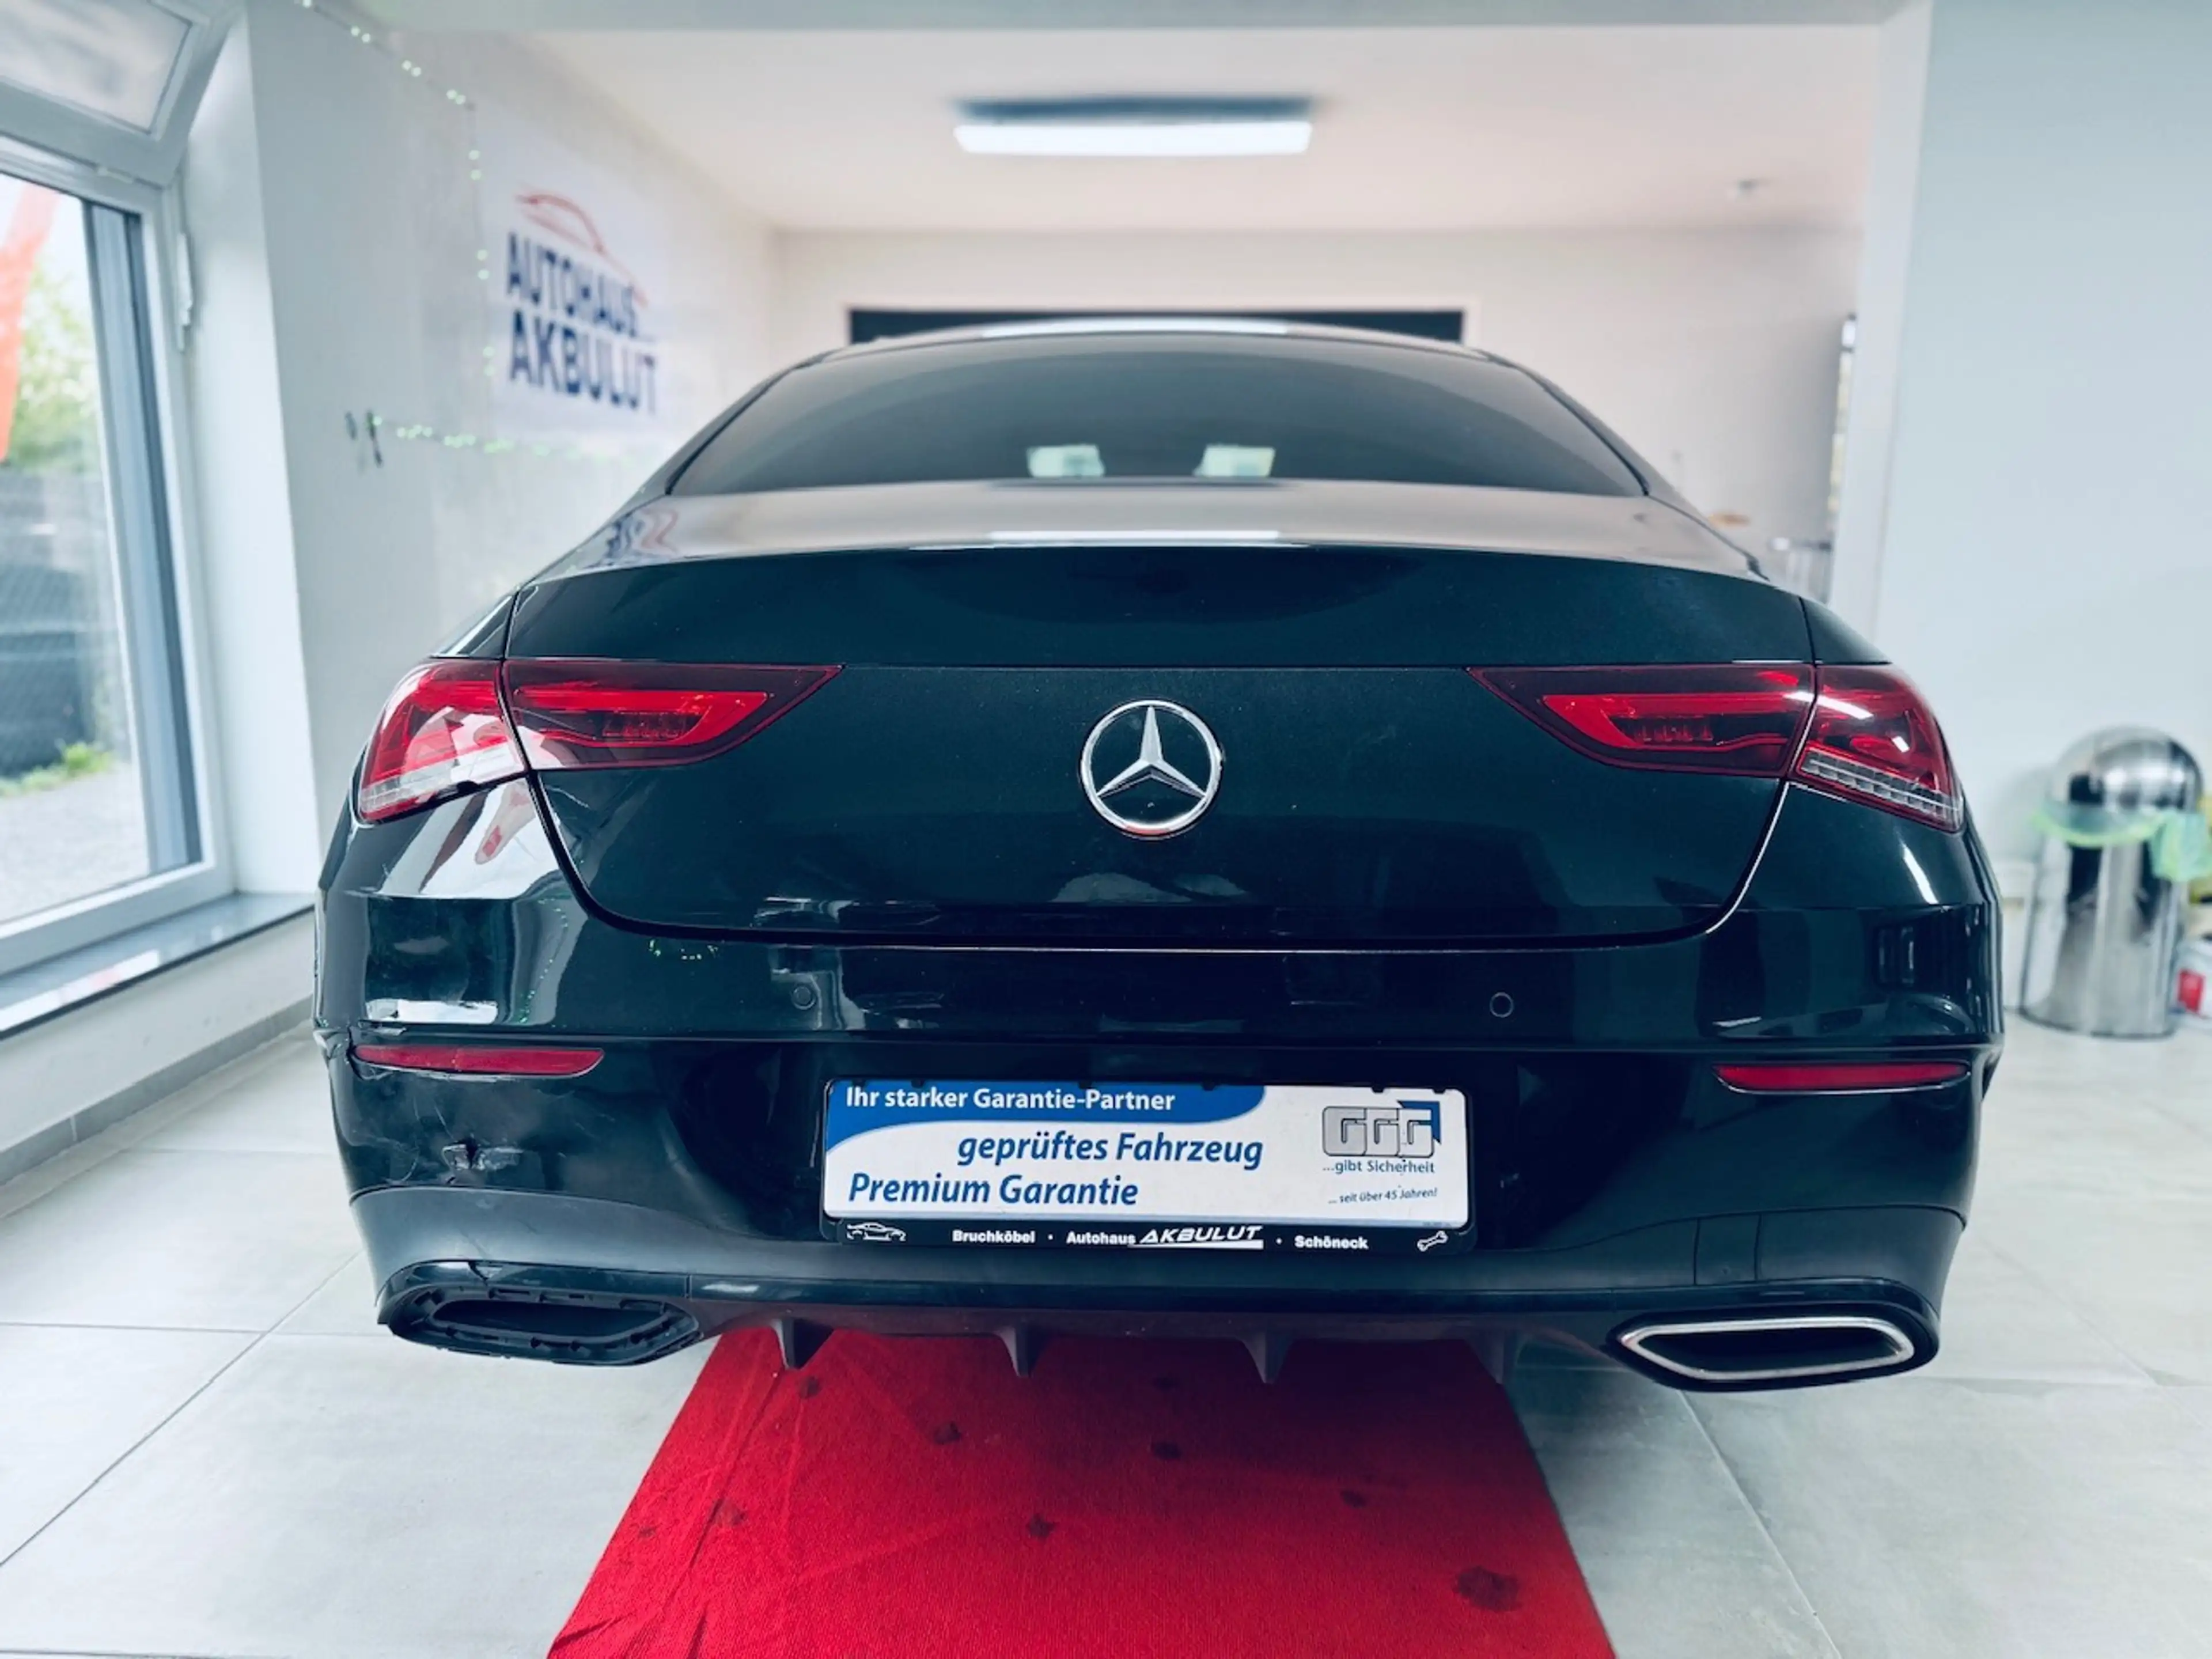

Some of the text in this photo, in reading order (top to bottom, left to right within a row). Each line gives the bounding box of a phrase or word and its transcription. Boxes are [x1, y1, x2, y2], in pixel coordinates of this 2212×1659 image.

[507, 230, 641, 339] AUTOHAUS
[509, 309, 657, 415] AKBULUT
[846, 1087, 1175, 1110] Ihr starker Garantie-Partner
[957, 1130, 1263, 1170] geprüftes Fahrzeug
[1366, 1160, 1435, 1173] Sicherheit
[849, 1172, 1138, 1205] Premium Garantie
[952, 1225, 1369, 1249] Bruchköbel Autohaus AKBULUT Schöneck
